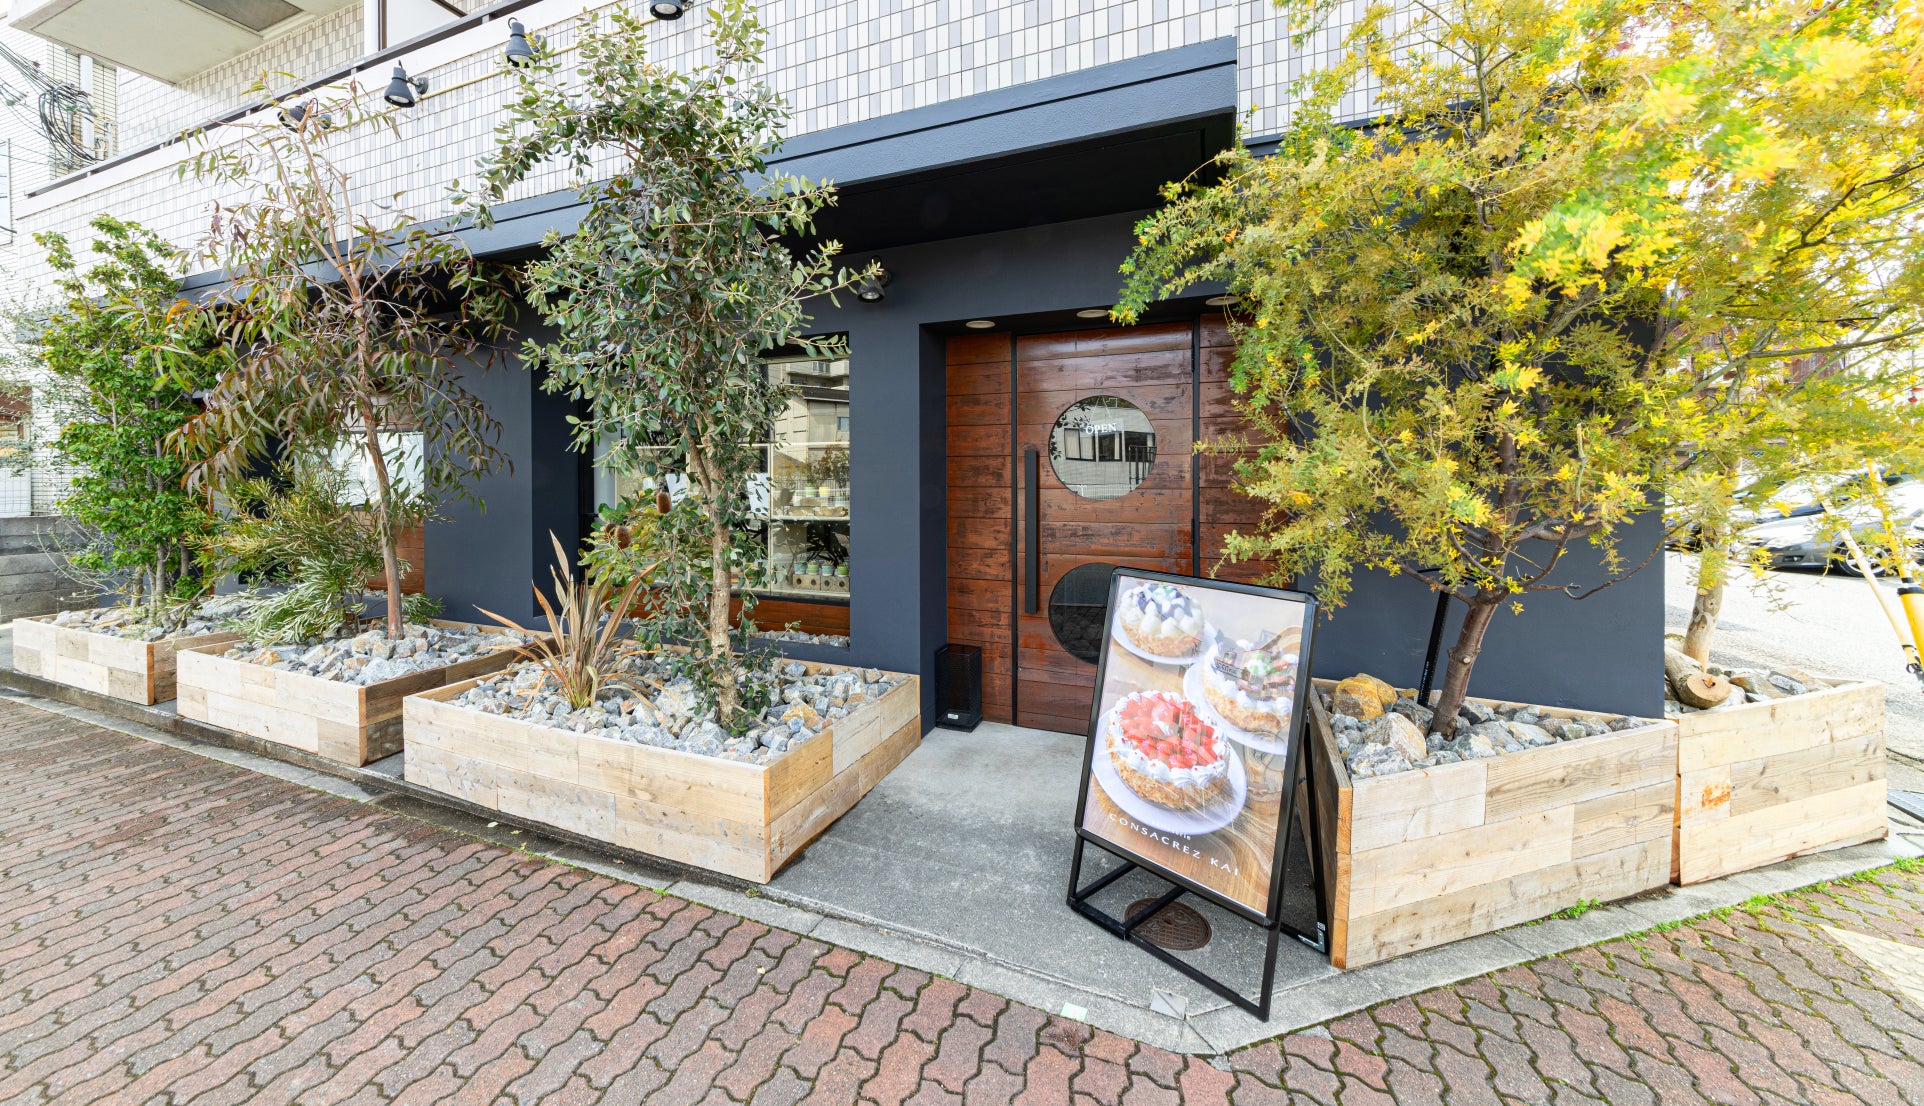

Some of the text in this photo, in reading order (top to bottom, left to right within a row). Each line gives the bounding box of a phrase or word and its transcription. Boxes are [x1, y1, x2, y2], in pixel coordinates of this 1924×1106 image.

[1085, 422, 1117, 435] OPEN
[1109, 813, 1201, 859] CONSACREZ
[1210, 857, 1239, 876] KAI
